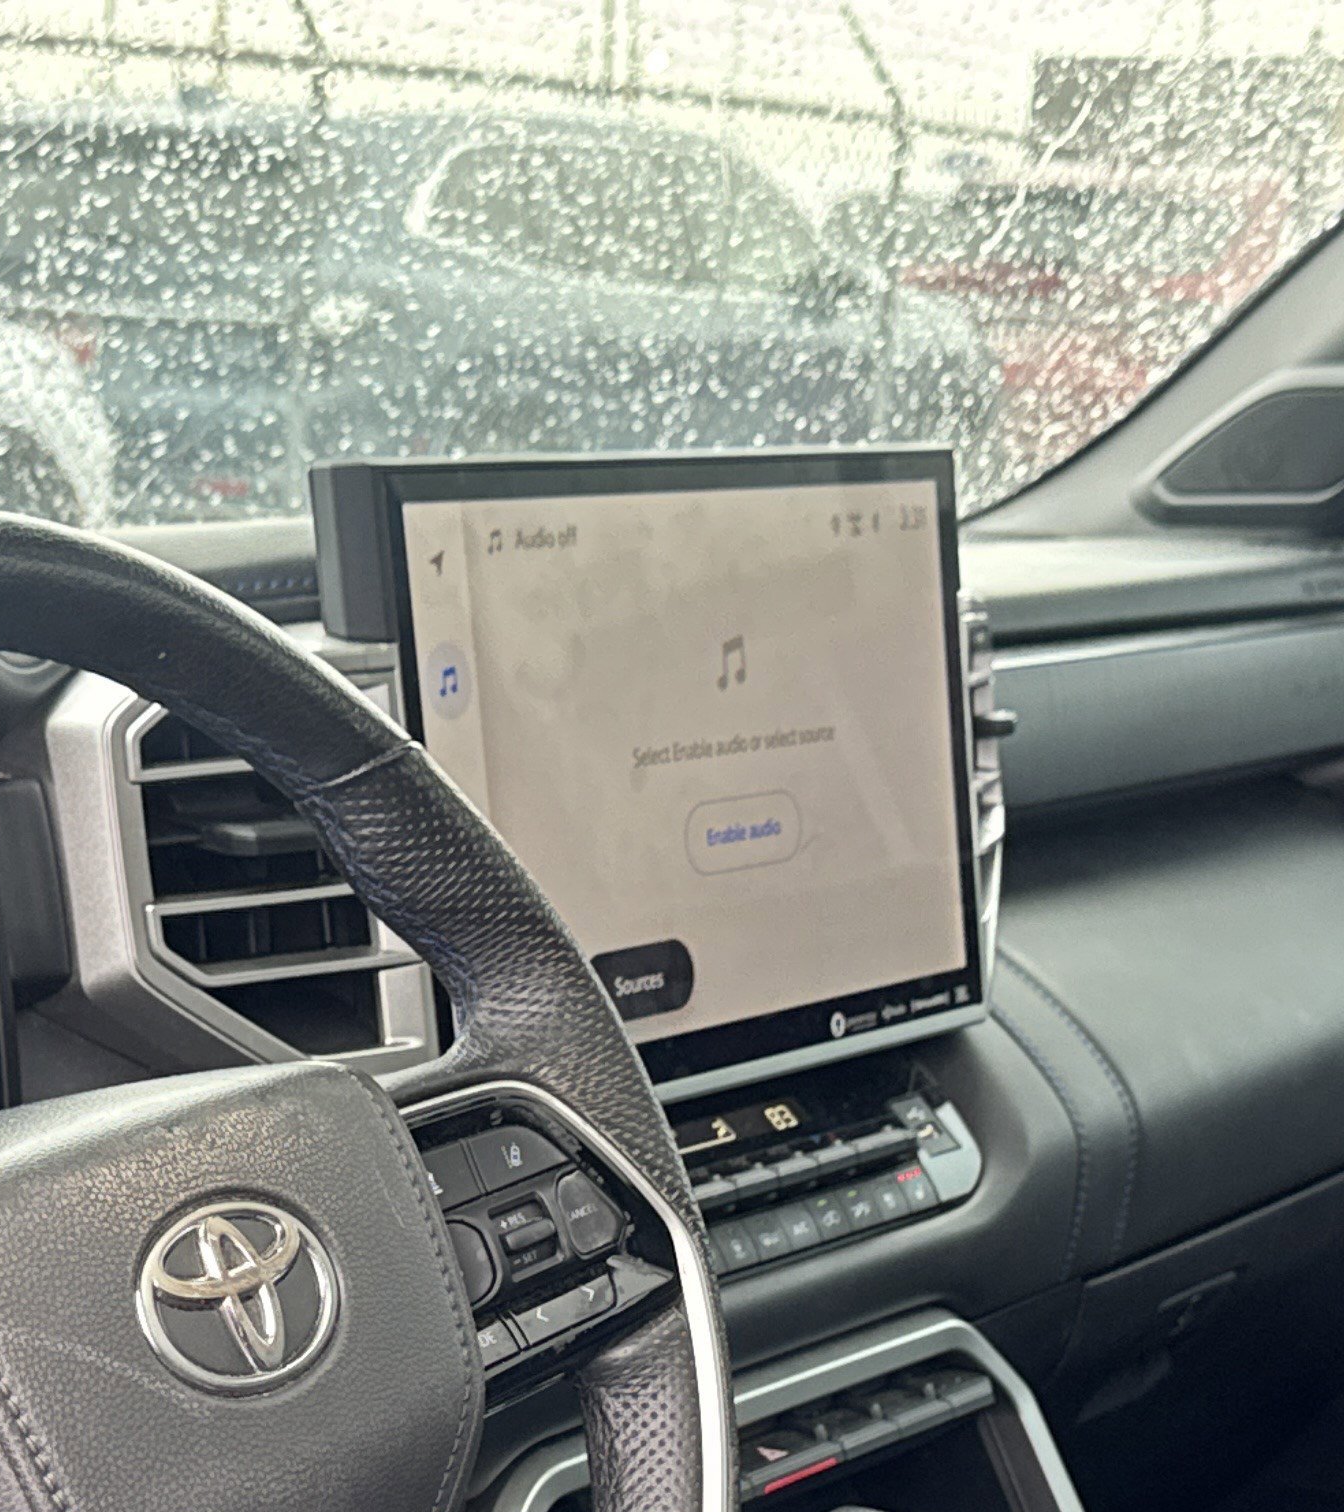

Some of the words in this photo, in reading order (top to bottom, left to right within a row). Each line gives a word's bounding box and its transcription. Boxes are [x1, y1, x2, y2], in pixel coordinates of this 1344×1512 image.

[515, 527, 556, 550] Audio
[558, 524, 578, 549] off
[633, 746, 671, 769] Select
[672, 741, 713, 763] Enable
[716, 734, 748, 757] audio
[764, 729, 797, 750] select
[799, 726, 835, 746] source
[706, 823, 747, 846] Enable
[749, 817, 782, 840] audio
[614, 972, 665, 998] Sources
